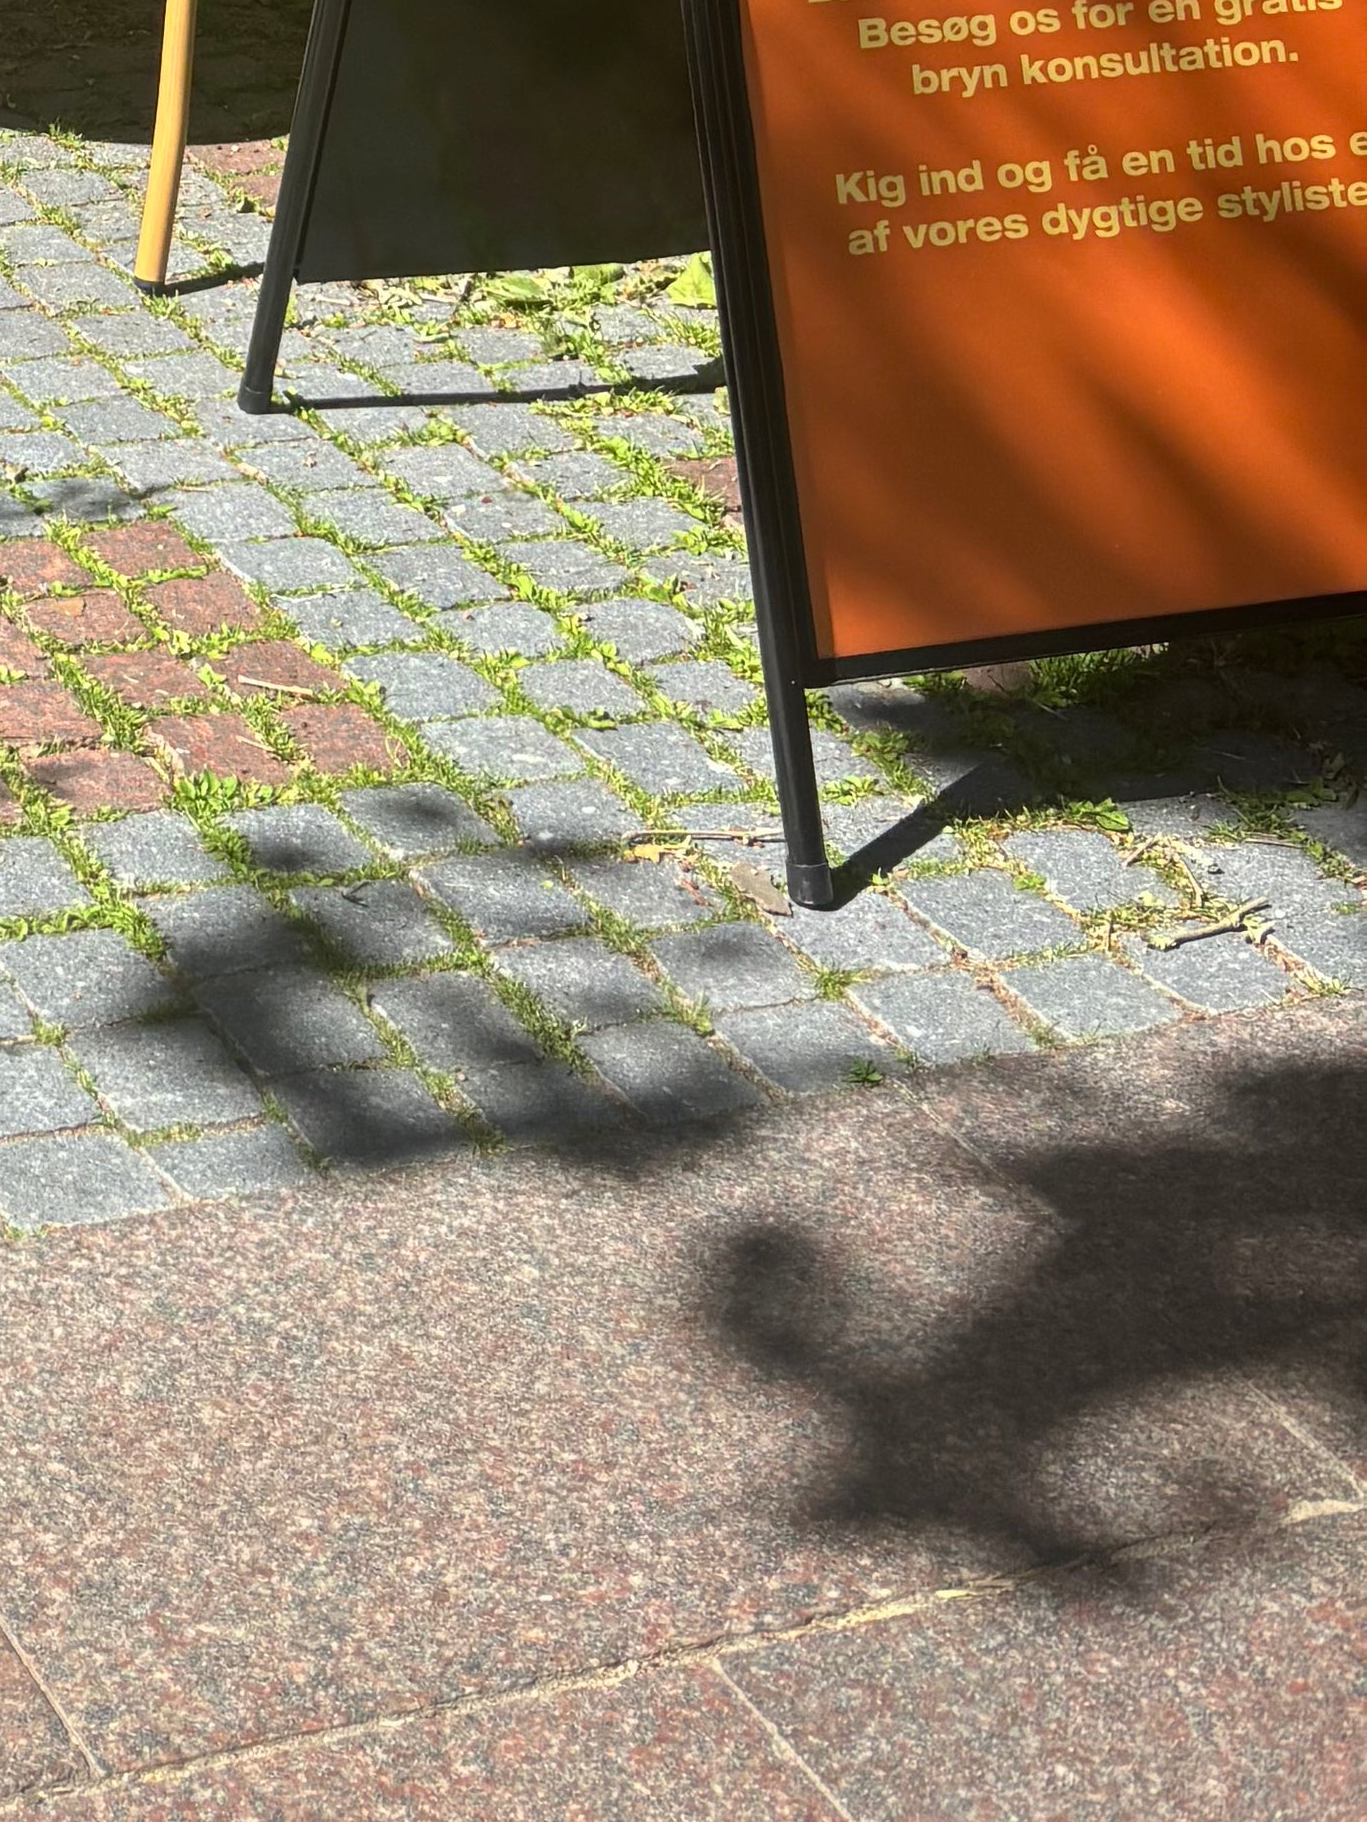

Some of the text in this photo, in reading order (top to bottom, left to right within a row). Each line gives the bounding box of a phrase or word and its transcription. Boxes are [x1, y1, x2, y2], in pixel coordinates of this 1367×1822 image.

[857, 11, 998, 51] Besøg
[1009, 1, 1062, 37] os
[911, 36, 1299, 97] bryn konsultation.
[834, 168, 907, 212] Kig
[918, 159, 986, 198] ind
[997, 159, 1053, 196] og
[1063, 143, 1109, 184] få
[1122, 148, 1176, 177] en
[1186, 136, 1244, 171] tid
[1255, 133, 1337, 165] hos
[848, 219, 891, 257] af
[902, 214, 1031, 251] vores
[1040, 196, 1204, 242] dygtige
